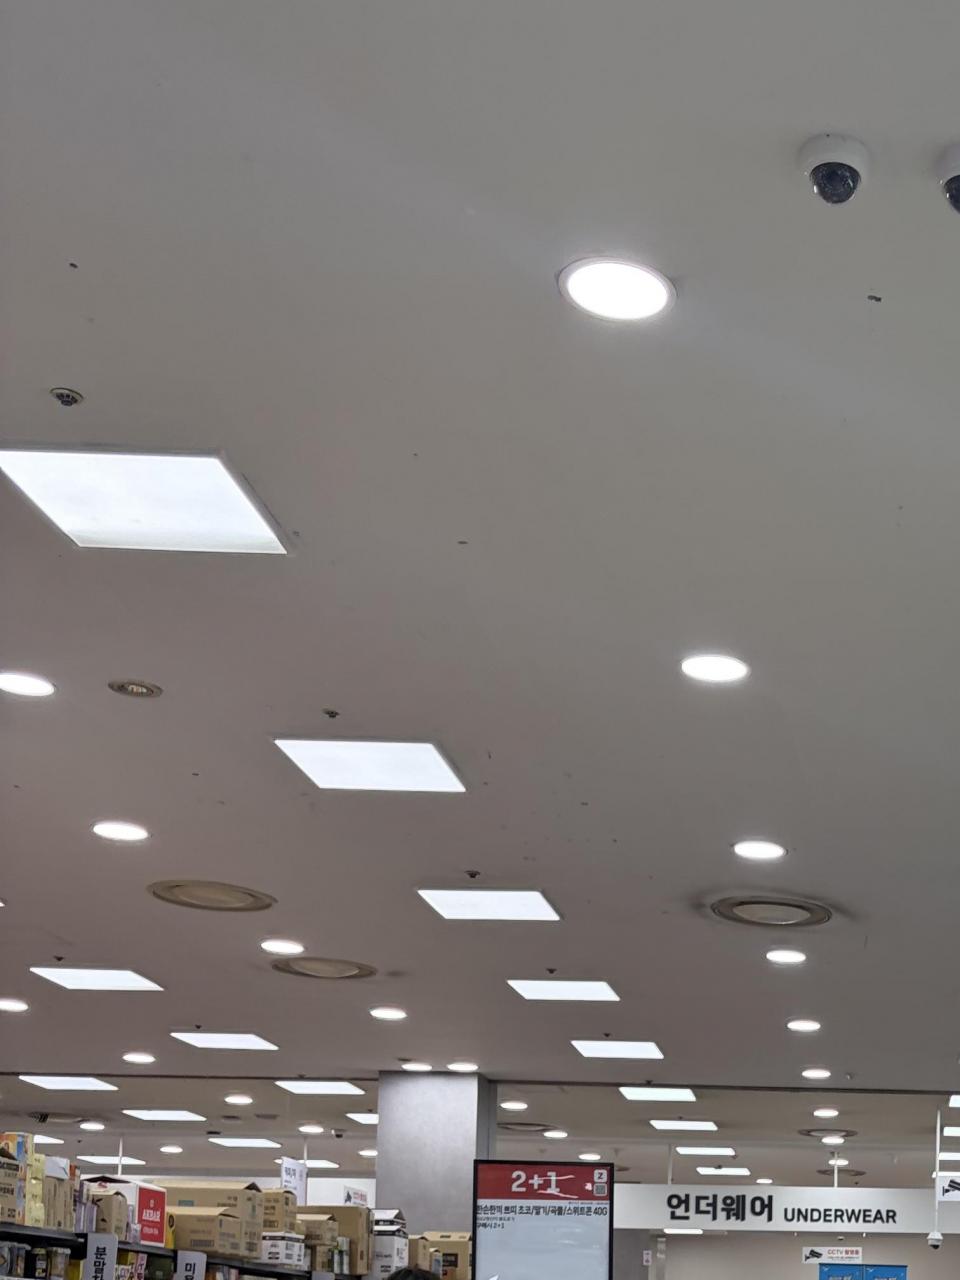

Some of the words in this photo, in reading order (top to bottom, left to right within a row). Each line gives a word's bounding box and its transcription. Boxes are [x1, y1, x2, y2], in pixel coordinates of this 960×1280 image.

[511, 1170, 560, 1193] 2+1
[593, 1206, 608, 1216] 40G
[666, 1193, 774, 1223] 언더웨어
[783, 1207, 898, 1224] UNDERWEAR
